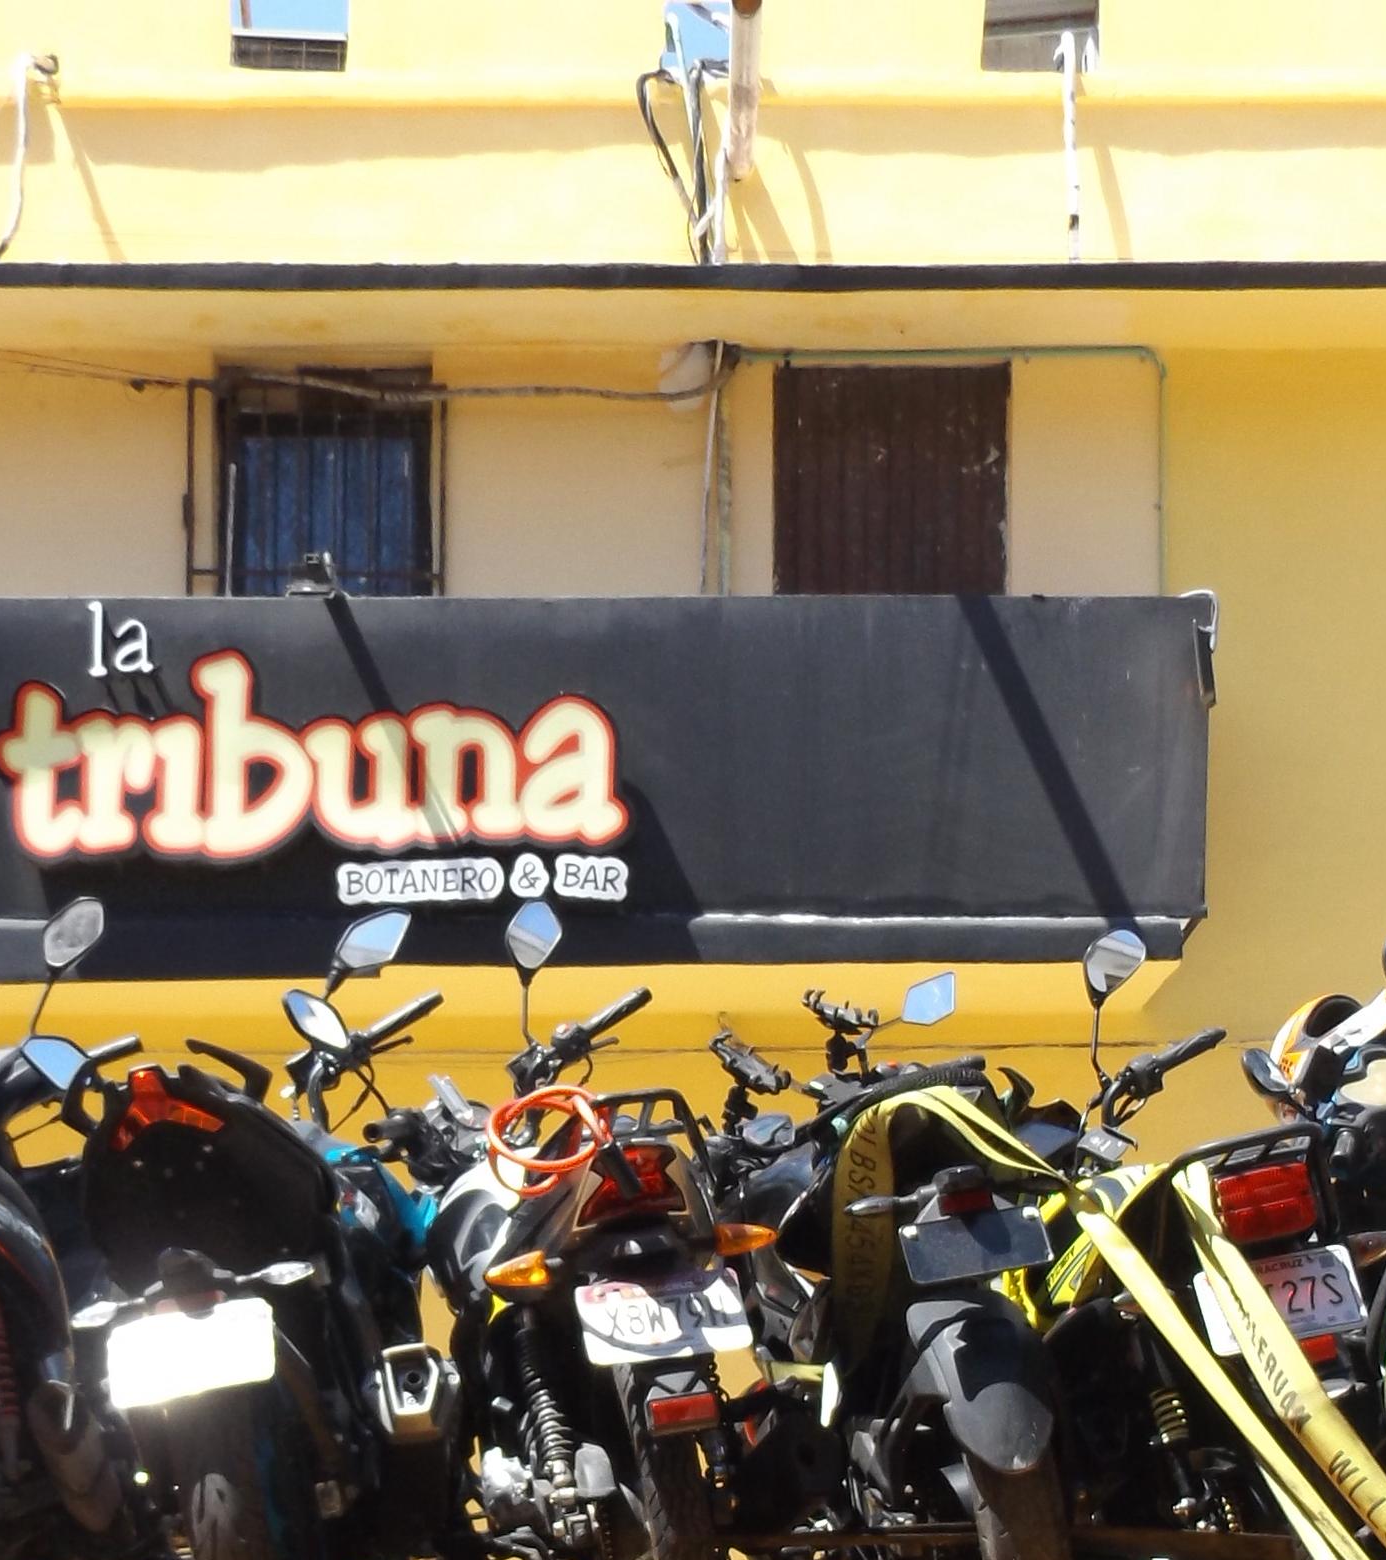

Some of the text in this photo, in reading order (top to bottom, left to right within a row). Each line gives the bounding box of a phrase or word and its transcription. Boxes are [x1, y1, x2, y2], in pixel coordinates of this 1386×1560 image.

[87, 601, 153, 677] la
[344, 862, 622, 897] BOTANERO & BAR
[1253, 1256, 1305, 1278] RACRUZ
